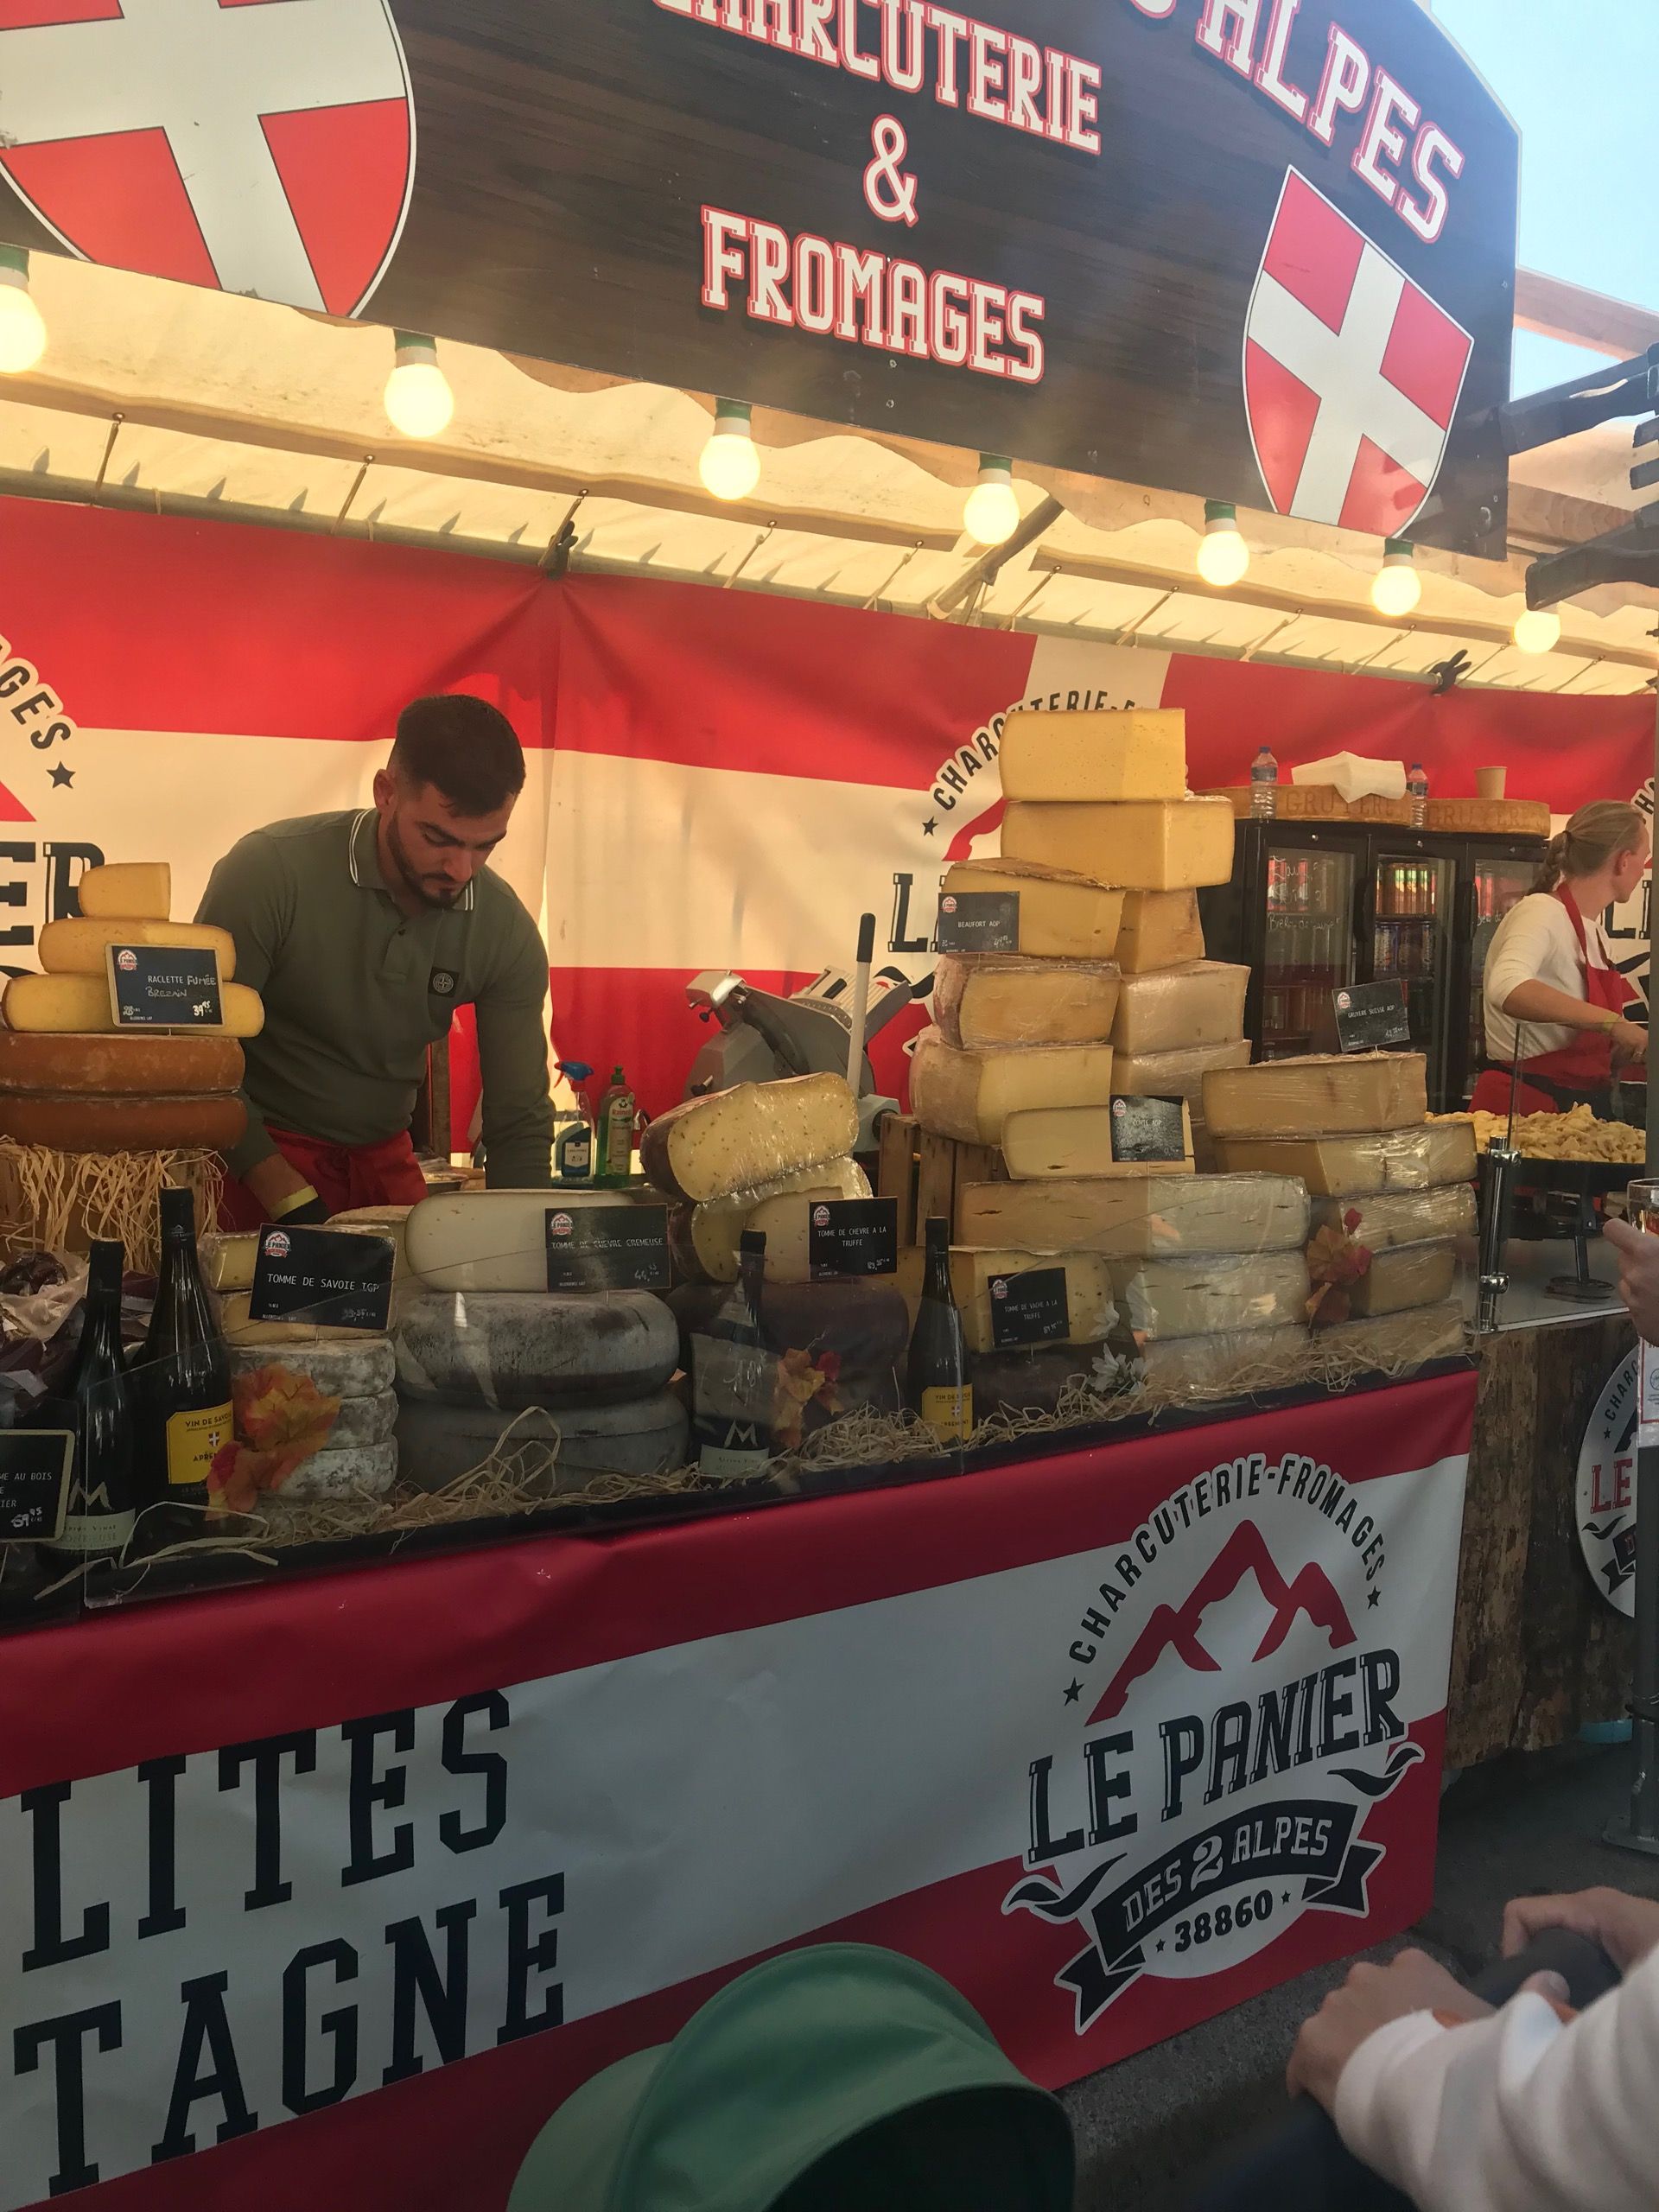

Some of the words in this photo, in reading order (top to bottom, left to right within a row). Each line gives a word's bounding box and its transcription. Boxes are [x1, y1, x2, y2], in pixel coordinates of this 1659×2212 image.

[863, 114, 918, 227] &
[701, 204, 1046, 385] FROMAGES
[148, 975, 184, 984] RACLETTE
[1348, 1009, 1367, 1019] GRUYERE
[1369, 1006, 1385, 1015] SUISSE
[552, 1241, 576, 1250] TOMME
[626, 1237, 664, 1248] CREMEUSE
[817, 1229, 836, 1237] TOMME
[838, 1228, 846, 1236] DE
[849, 1226, 870, 1236] CHEVRE
[872, 1226, 877, 1235] A
[879, 1225, 887, 1234] LA
[842, 1238, 863, 1247] TRUFFE
[267, 1273, 297, 1285] TOMME
[302, 1276, 315, 1287] DE
[321, 1278, 356, 1291] SAVOIE
[361, 1282, 380, 1293] IGP
[1004, 1304, 1019, 1313] TOMME
[185, 1420, 200, 1428] VIN
[202, 1417, 213, 1426] DE
[15, 1472, 26, 1481] AU
[30, 1471, 53, 1481] BOIS
[1590, 1459, 1633, 1515] LE
[1069, 1459, 1386, 1664] CHARCUTERIE-FROMAGES
[1028, 1730, 1138, 1864] LE
[1160, 1648, 1405, 1822] PANIER
[21, 1688, 511, 1973] LITES
[1124, 1863, 1183, 1933] DES
[1191, 1834, 1224, 1893] 2
[1230, 1815, 1333, 1866] ALPES
[1173, 1889, 1274, 1953] 38860
[12, 1871, 566, 2198] TAGNE
